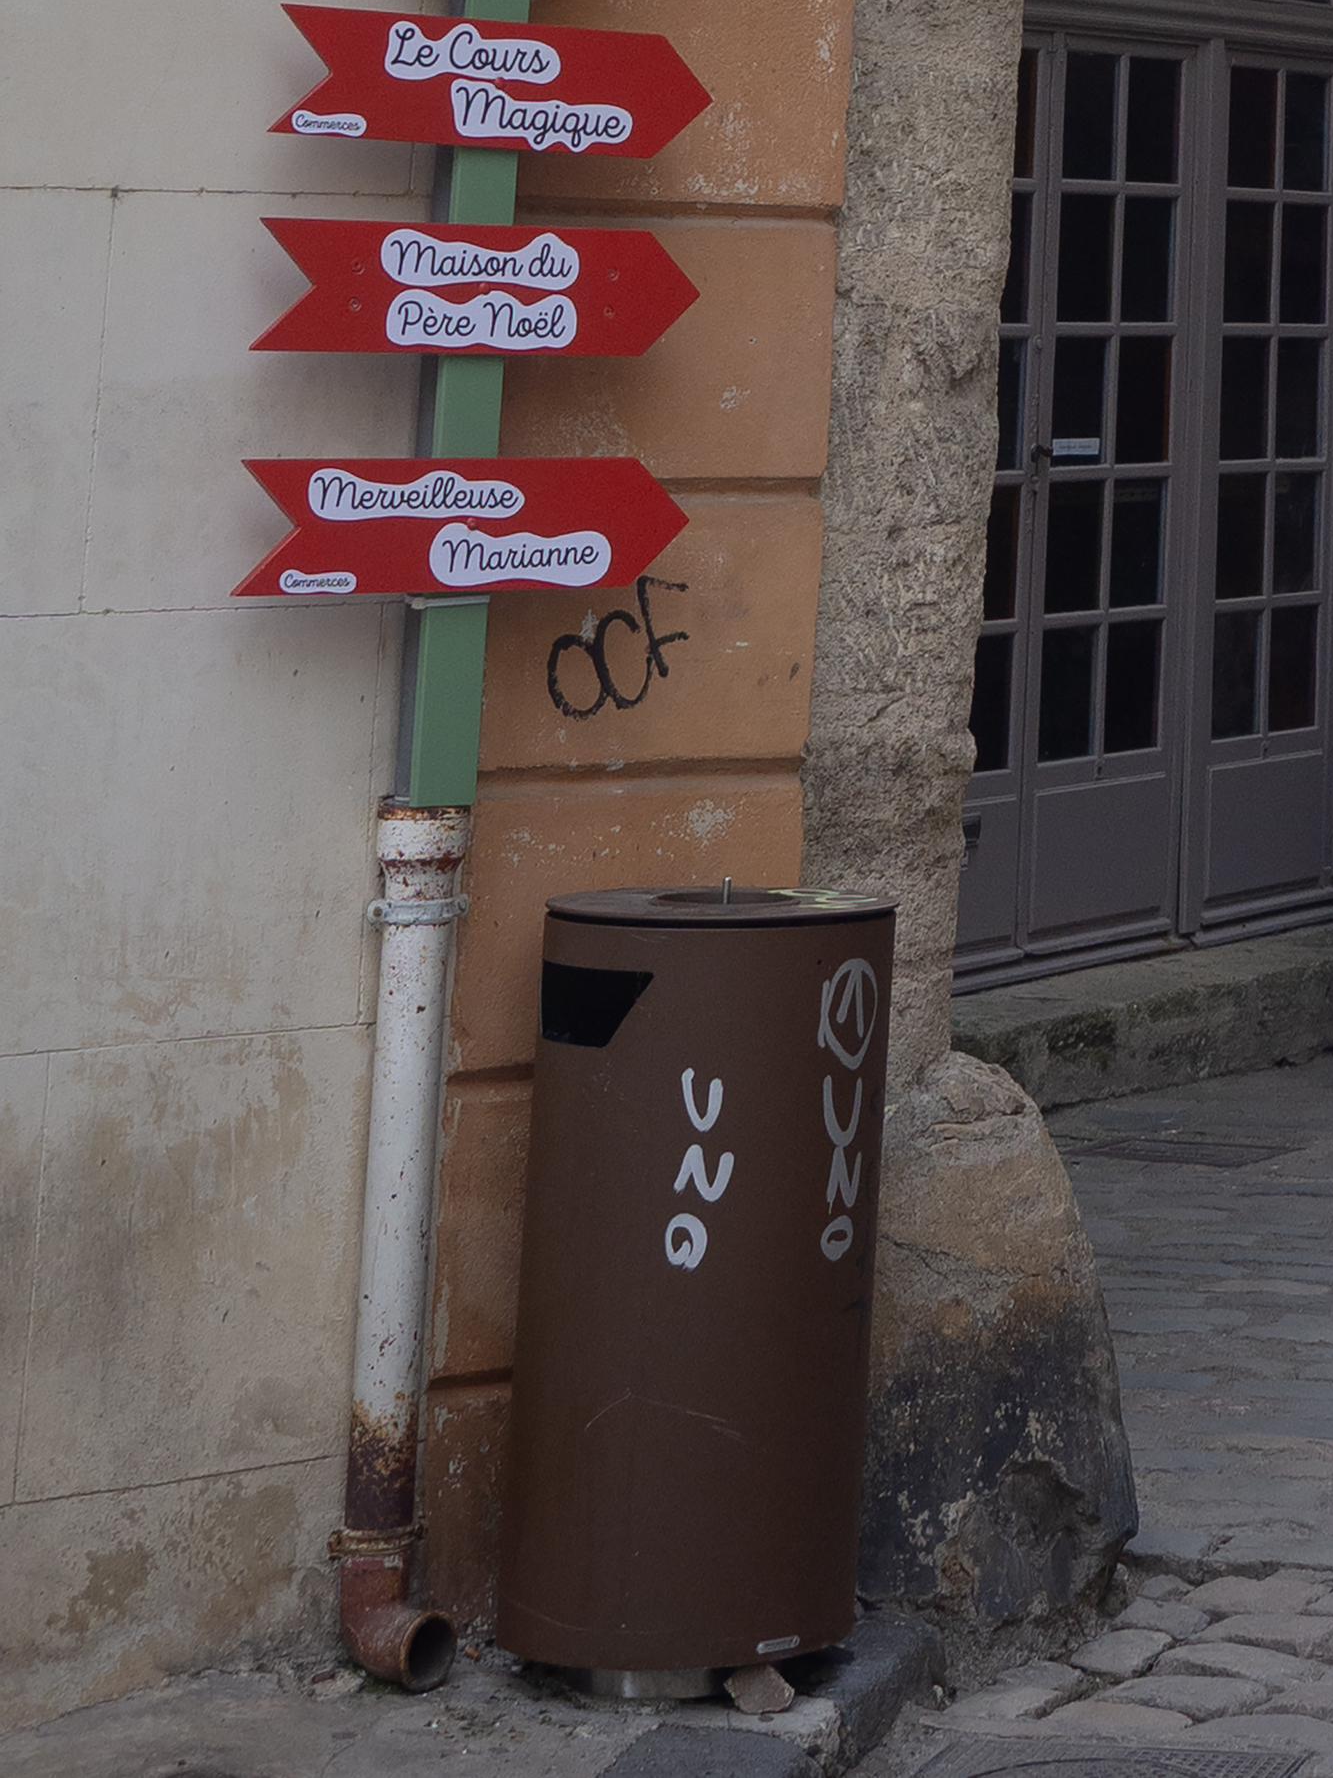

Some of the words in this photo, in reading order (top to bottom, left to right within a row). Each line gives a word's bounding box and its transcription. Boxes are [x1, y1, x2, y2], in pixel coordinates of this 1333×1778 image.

[391, 28, 440, 70] Le
[449, 29, 550, 76] Cours
[295, 113, 362, 133] Commerces
[456, 84, 626, 149] Magique
[391, 239, 523, 279] Maison
[528, 237, 573, 280] du
[398, 299, 475, 339] Père
[484, 295, 567, 339] Noël
[314, 474, 520, 514] Merveilleuse
[442, 539, 600, 576] Marianne
[283, 572, 353, 591] Commerces
